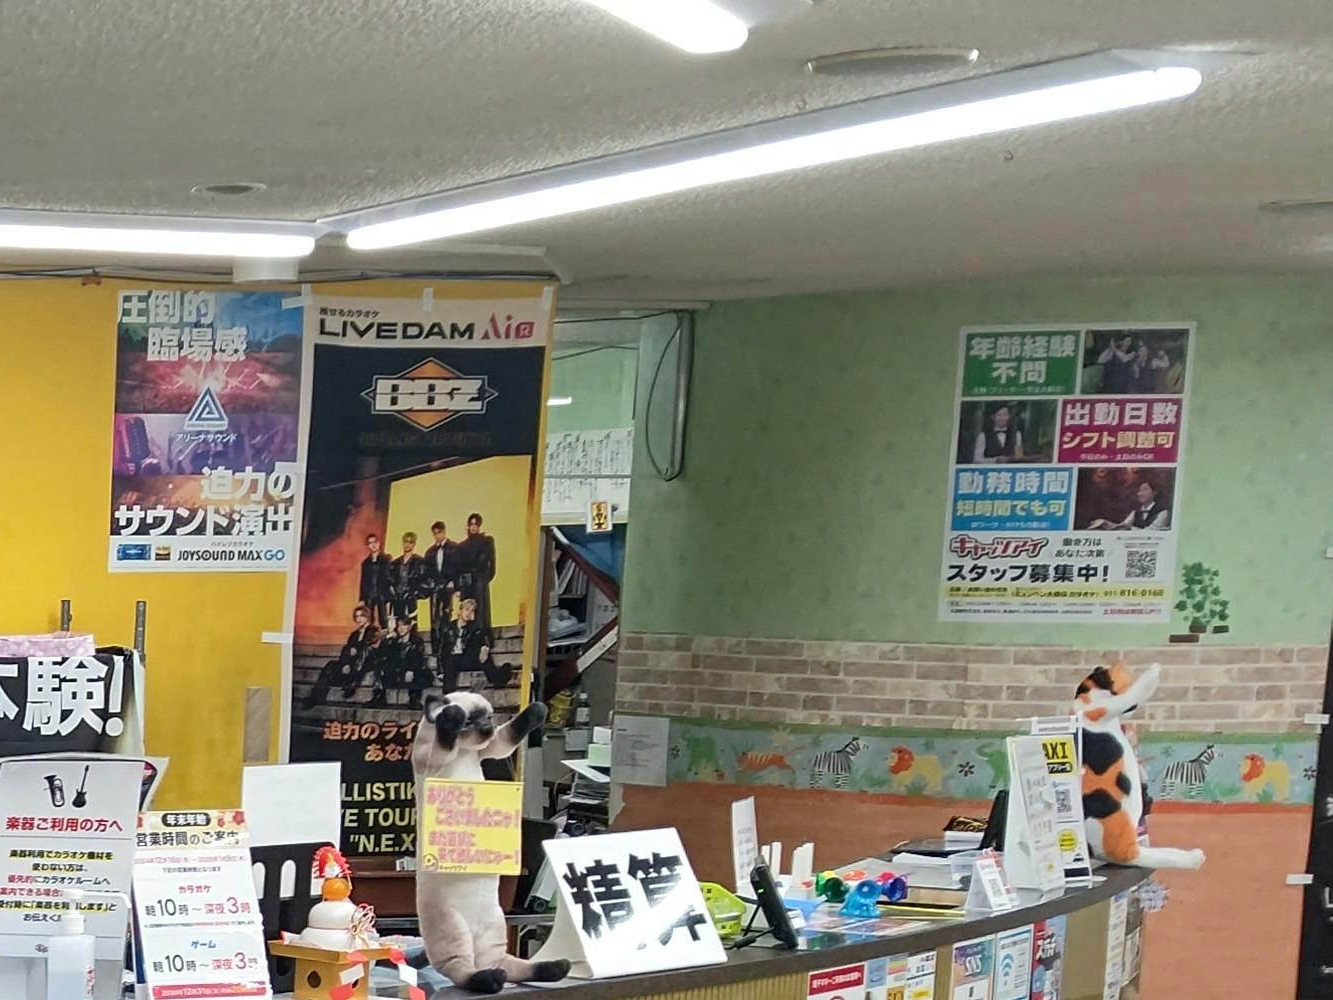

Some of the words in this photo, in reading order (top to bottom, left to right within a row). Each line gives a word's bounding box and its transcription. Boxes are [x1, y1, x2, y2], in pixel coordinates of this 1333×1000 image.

[117, 290, 215, 324] 圧倒的
[147, 326, 249, 362] 臨場感
[969, 335, 1077, 359] 年齢経験
[992, 361, 1047, 384] 不問
[1061, 431, 1175, 449] シフト調整可
[201, 466, 296, 501] 迫力の
[957, 472, 1070, 494] 勤務時間
[956, 500, 1067, 517] 短時間でも可
[115, 504, 293, 536] サウンド演出
[950, 533, 1049, 560] キャッツアイ
[1063, 538, 1102, 547] 働き方は
[177, 550, 235, 561] JOYSOUND
[947, 563, 1109, 583] スタッフ募集中!
[6, 817, 123, 832] 楽器ご利用の方へ
[165, 814, 208, 826] 年末年始
[10, 849, 113, 860] 楽器利用でカラオケ機材を
[7, 875, 110, 885] 優先的にカラオケルームへ
[179, 885, 211, 894] カラオケ
[190, 941, 217, 949] ゲーム
